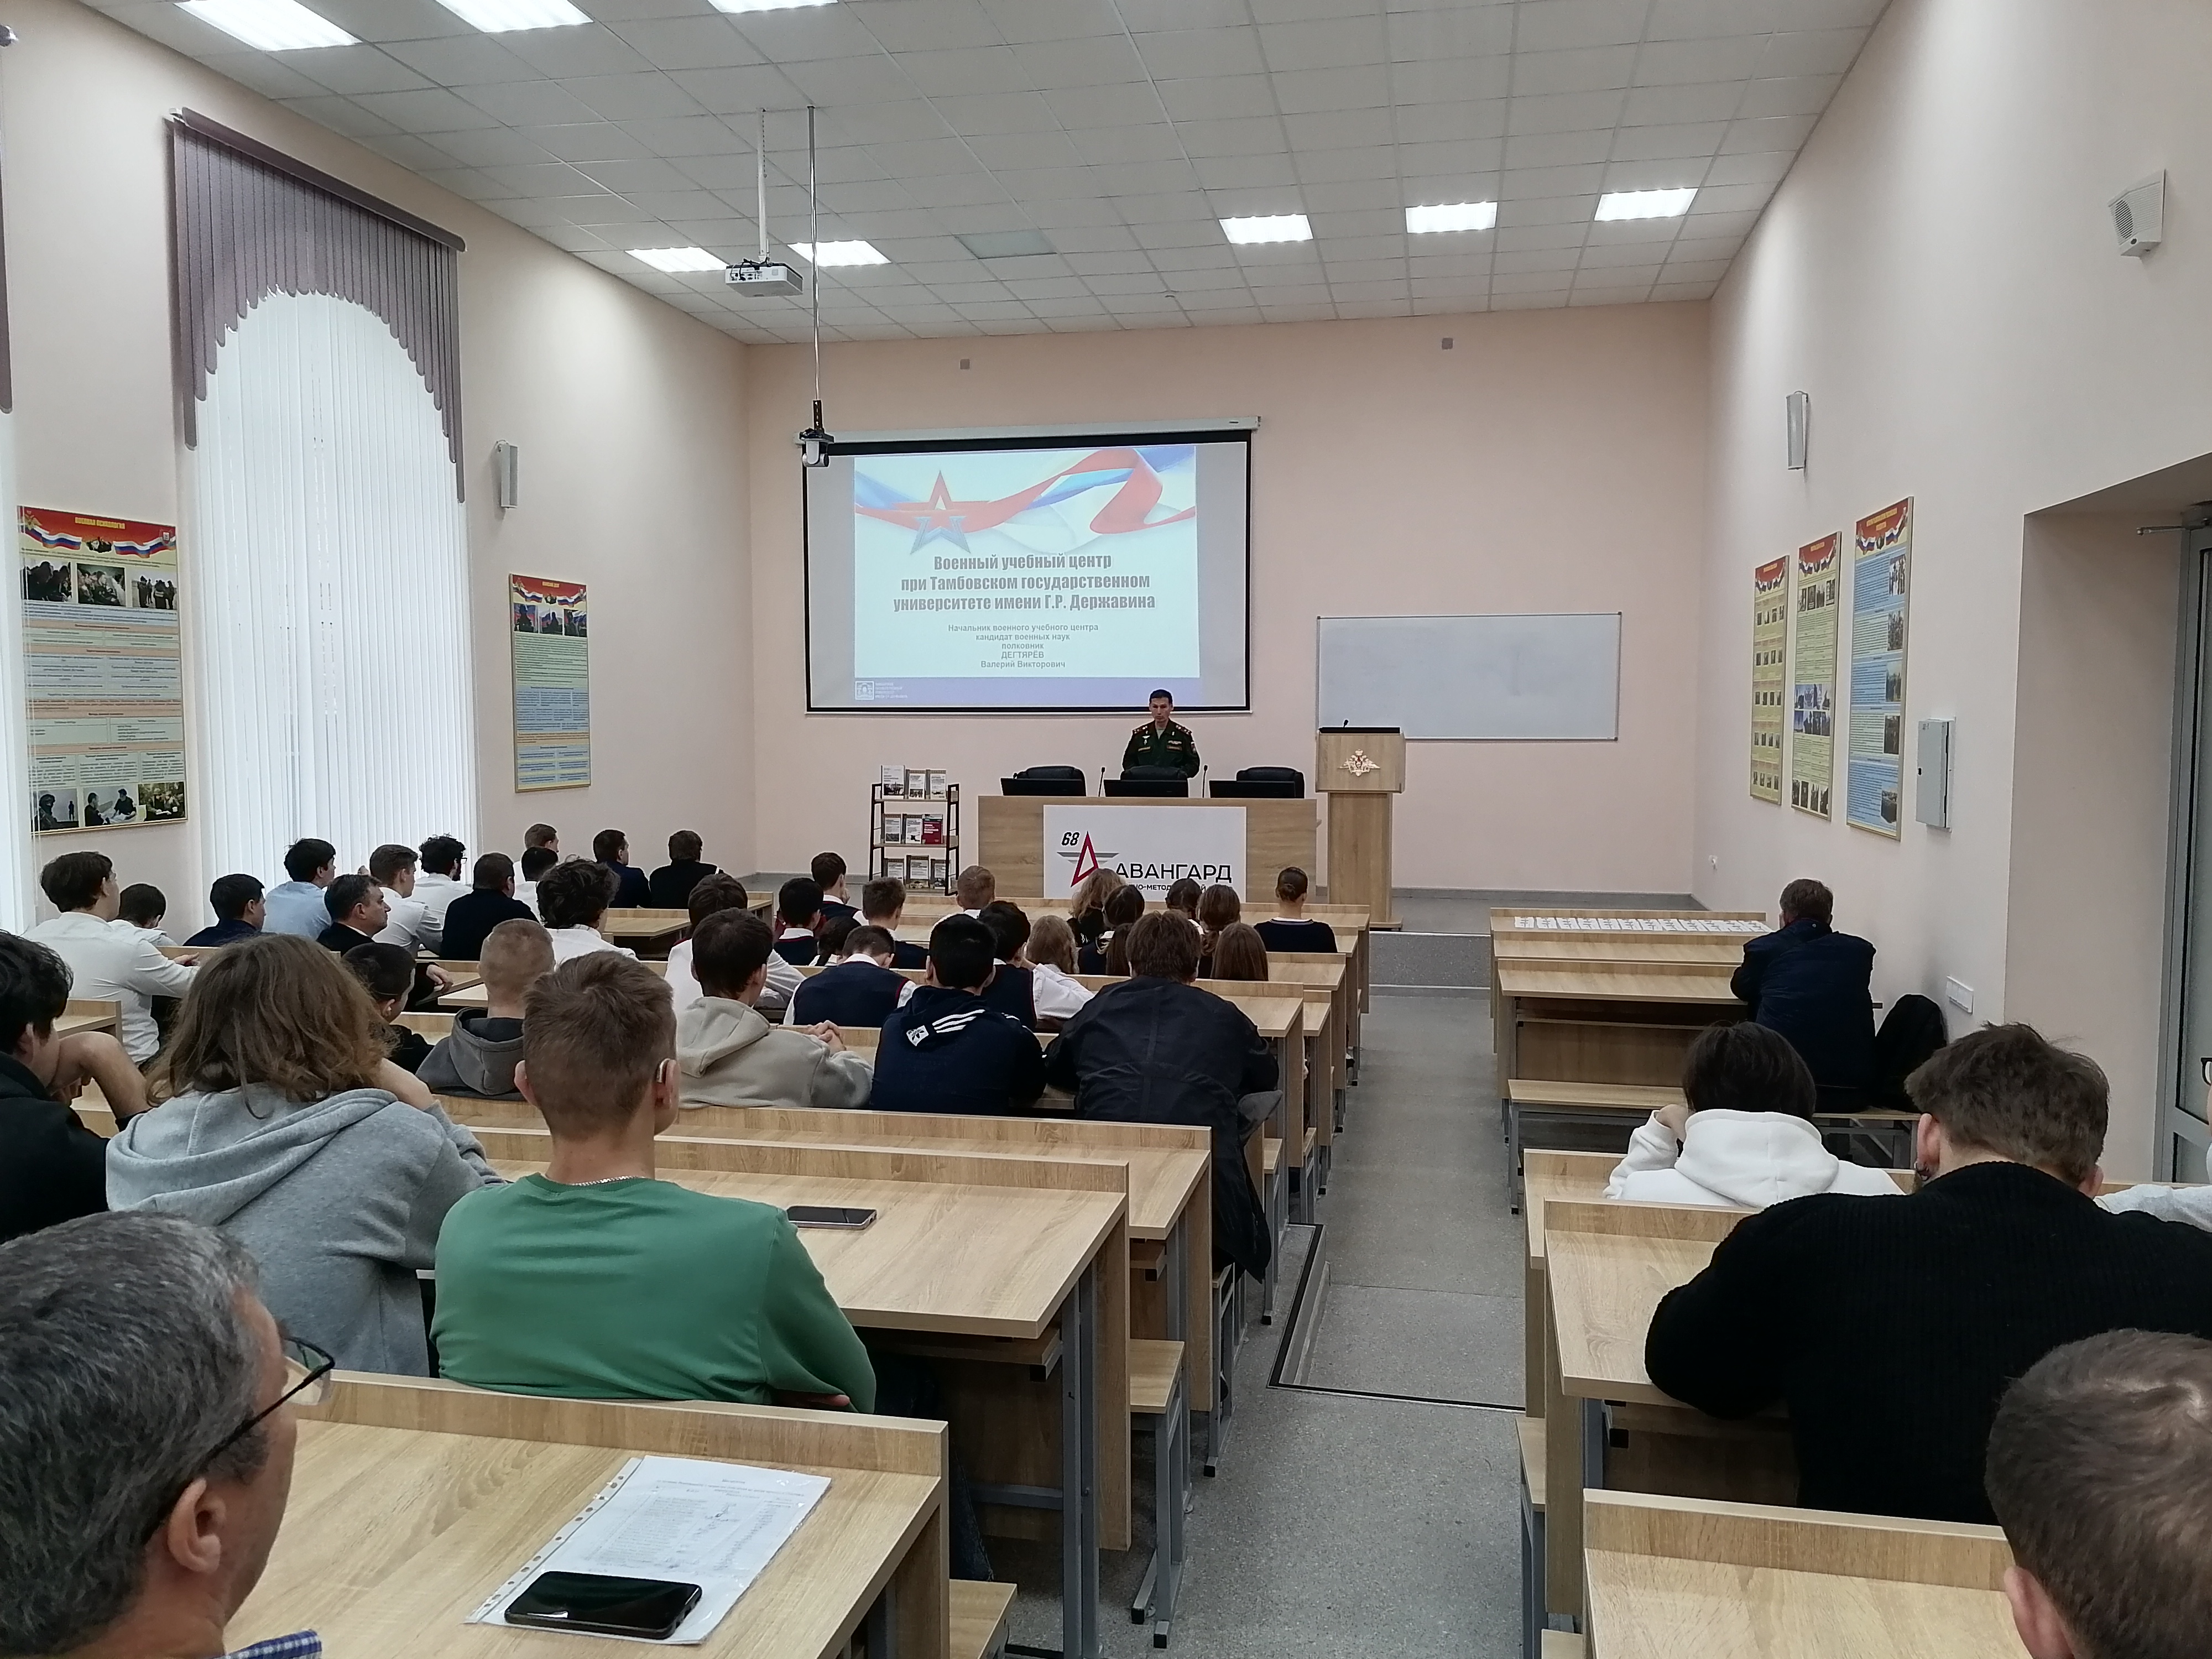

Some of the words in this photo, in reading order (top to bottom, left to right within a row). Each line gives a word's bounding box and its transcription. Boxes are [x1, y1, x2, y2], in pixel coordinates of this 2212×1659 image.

[934, 555, 997, 570] Военный
[1001, 554, 1065, 571] учебный
[1069, 554, 1112, 570] центр
[901, 578, 927, 592] при
[930, 576, 1018, 590] Тамбовском
[1021, 575, 1150, 591] государственном
[894, 597, 991, 612] университете
[994, 596, 1041, 610] имени
[1045, 594, 1067, 609] Г.Р.
[1070, 594, 1155, 611] Державина
[1031, 624, 1068, 632] учебного
[1070, 624, 1099, 632] центра
[1001, 650, 1044, 660] ДЕГТЯРЁВ
[980, 660, 1015, 669] Валерий
[1017, 660, 1066, 669] Викторович
[1062, 832, 1080, 846] 68
[1116, 863, 1232, 884] АВАНГАРД
